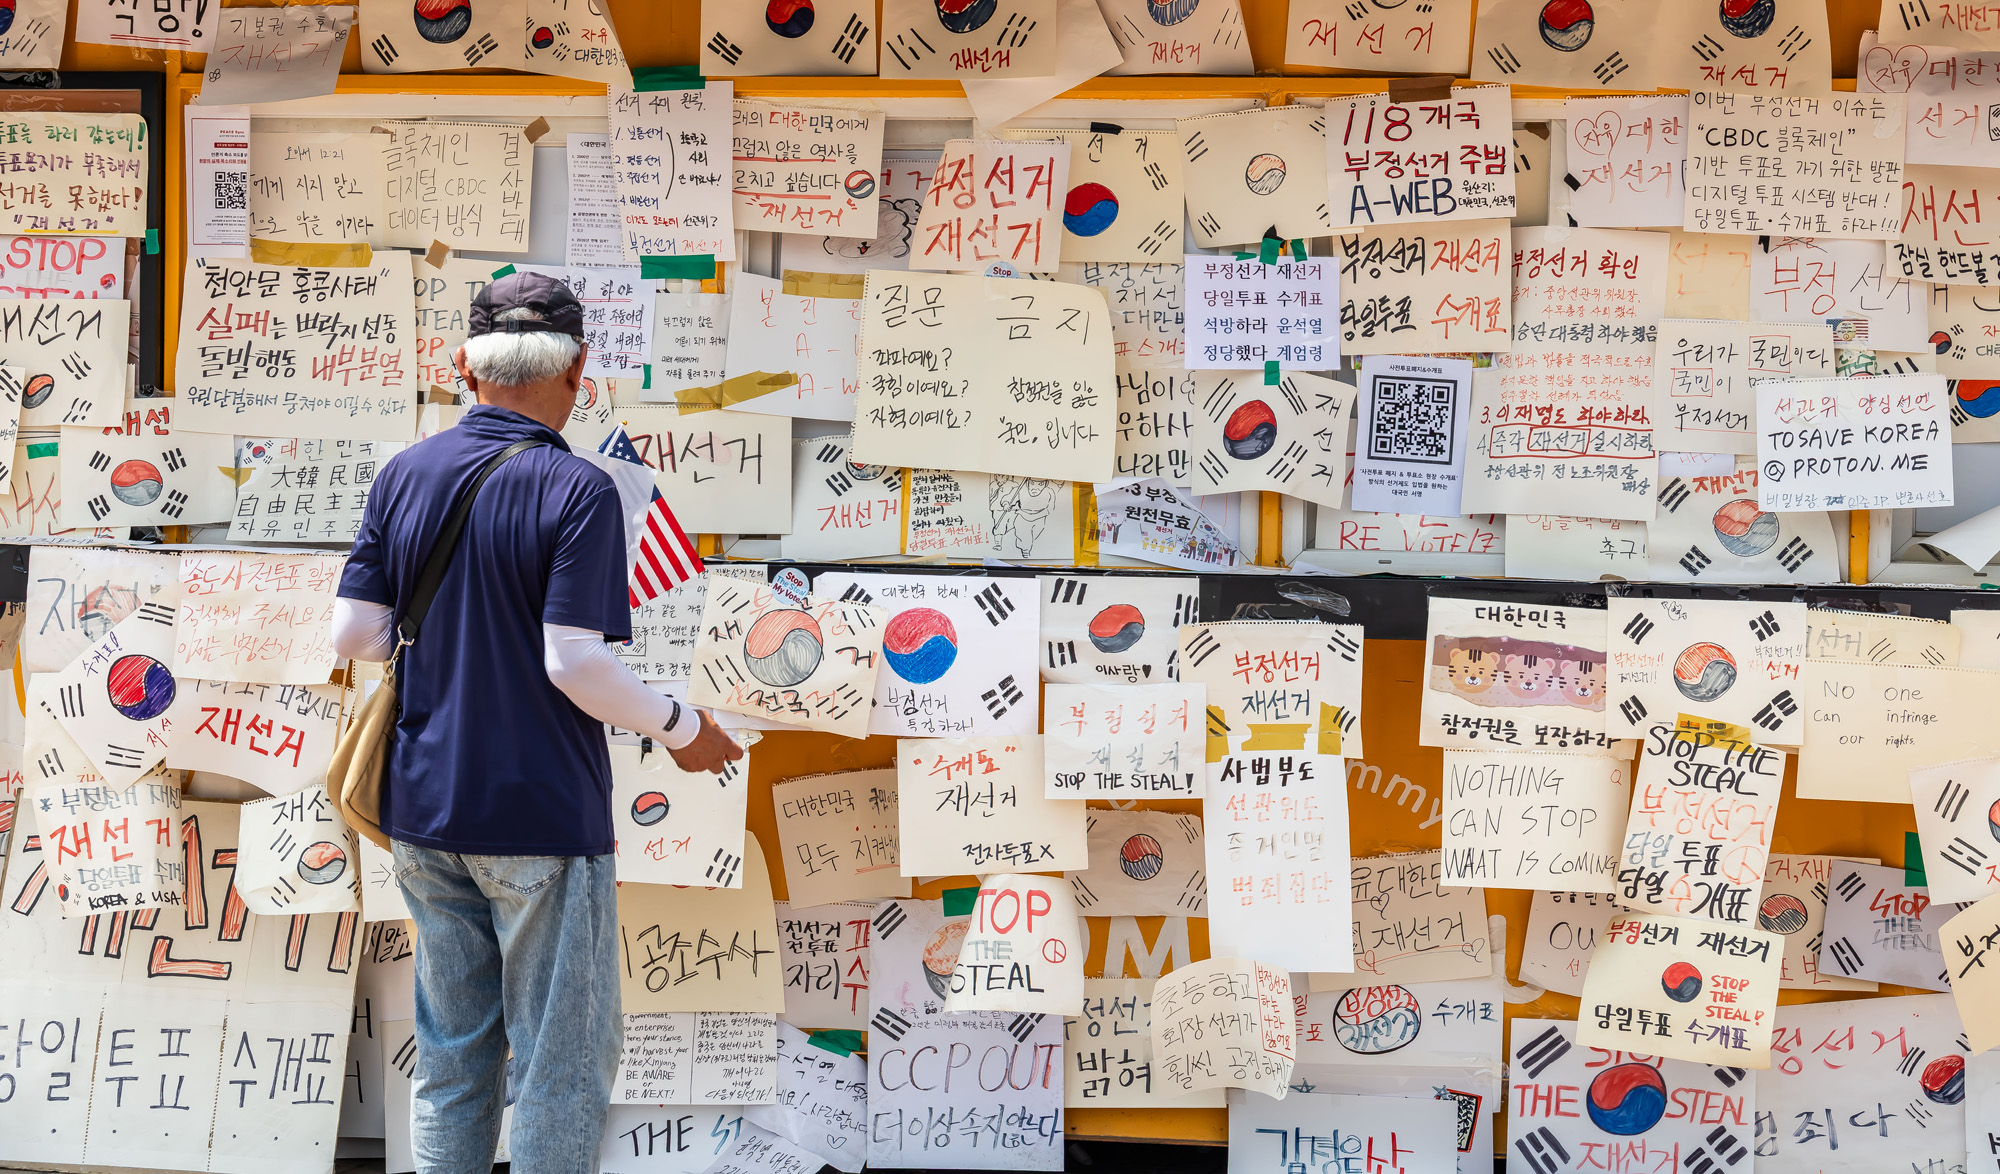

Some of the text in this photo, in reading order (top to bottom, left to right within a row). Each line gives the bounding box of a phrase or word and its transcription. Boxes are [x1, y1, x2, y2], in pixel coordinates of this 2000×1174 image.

[230, 16, 284, 39] 기본권
[581, 28, 608, 43] 자유
[1302, 19, 1433, 56] 재선거
[222, 42, 333, 71] 재선거
[950, 48, 1010, 72] 재선거
[1148, 41, 1201, 64] 재선거
[1700, 64, 1788, 89] 재선거
[1419, 101, 1480, 130] 개국
[1833, 98, 1886, 119] 이슈는
[319, 148, 344, 159] 12:21
[810, 144, 857, 165] 역사를
[1344, 145, 1507, 181] 부정선거 주범
[928, 153, 1055, 211] 부정선거
[1580, 160, 1672, 203] 재선거
[1694, 155, 1900, 184] 기반 투표로 가기 위한 발판
[445, 178, 486, 196] CBDC
[1692, 184, 1836, 208] 디지털 투표 시스템
[1350, 178, 1457, 224] A-WEB
[388, 205, 439, 233] 데이터
[629, 231, 676, 255] 부정선거
[924, 214, 1043, 266] 재선거
[6, 238, 107, 274] STOP
[1340, 234, 1501, 284] 부정선거 재선거
[1598, 250, 1639, 280] 확인
[993, 266, 1012, 277] Stop
[1203, 263, 1322, 280] 부정선거 재선거
[1203, 290, 1323, 307] 당일투표 수개표
[196, 303, 397, 344] 실패는 선동
[664, 316, 692, 327] 부끄럽지
[1204, 318, 1323, 334] 석방하라 윤석열
[1431, 293, 1507, 340] 수개표
[197, 340, 404, 386] 돌발행동 내부분열
[1204, 345, 1323, 362] 정당했다 계엄령
[1672, 338, 1738, 366] 우리가
[1675, 370, 1731, 394] 국민이
[1496, 404, 1568, 425] 이재명도
[1675, 403, 1748, 432] 부정선거
[1531, 431, 1587, 453] 재선거
[1864, 420, 1939, 445] KOREA
[1764, 460, 1785, 482] @
[817, 499, 897, 531] 재선거
[1125, 506, 1191, 530] 원천무효
[1155, 526, 1173, 534] 재선거
[777, 575, 806, 596] The Steal
[786, 571, 803, 587] Stop
[881, 582, 926, 600] 대한민국
[772, 583, 800, 603] My Vote
[1475, 605, 1567, 629] 대한민국
[1232, 650, 1320, 684] 부정선거
[883, 687, 949, 717] 부정선거
[1823, 681, 1924, 702] No one
[1242, 689, 1311, 722] 재선거
[1813, 709, 1939, 726] Can infringe
[194, 706, 305, 768] 재선거
[1839, 735, 1864, 745] our
[1719, 739, 1779, 777] THE
[1054, 772, 1195, 795] STOP THE STEAL!
[1221, 756, 1314, 787] 사법부도
[1450, 763, 1622, 800] NOTHING Q
[1668, 761, 1758, 796] STEAL
[782, 789, 856, 819] 대한민국
[936, 781, 1016, 818] 재선거
[1225, 792, 1324, 822] 선관위도
[1450, 806, 1502, 837] CAN
[1638, 784, 1773, 846] 부정선거
[50, 818, 170, 866] 재선거
[1516, 850, 1539, 876] IS
[77, 864, 143, 892] 당일투표
[134, 892, 145, 905] &
[152, 890, 181, 906] USA
[1873, 917, 1922, 933] THE
[967, 940, 1013, 961] THE
[1606, 919, 1771, 963] 부정선거 재선거
[1258, 966, 1288, 994] 부정선거
[1710, 974, 1750, 992] STOP
[1261, 995, 1280, 1013] 하는
[1709, 990, 1738, 1004] THE
[1264, 1014, 1285, 1031] 나라
[1432, 997, 1498, 1026] 수개표
[634, 1024, 675, 1032] enterprises
[1594, 1003, 1751, 1051] 당일투표 수개표
[642, 1046, 673, 1055] harvest
[626, 1070, 675, 1080] BE AWARE
[978, 1042, 1062, 1092] OUT
[625, 1089, 675, 1100] BE NEXT!
[1513, 1083, 1749, 1126] THE STEAL
[619, 1115, 694, 1157] THE
